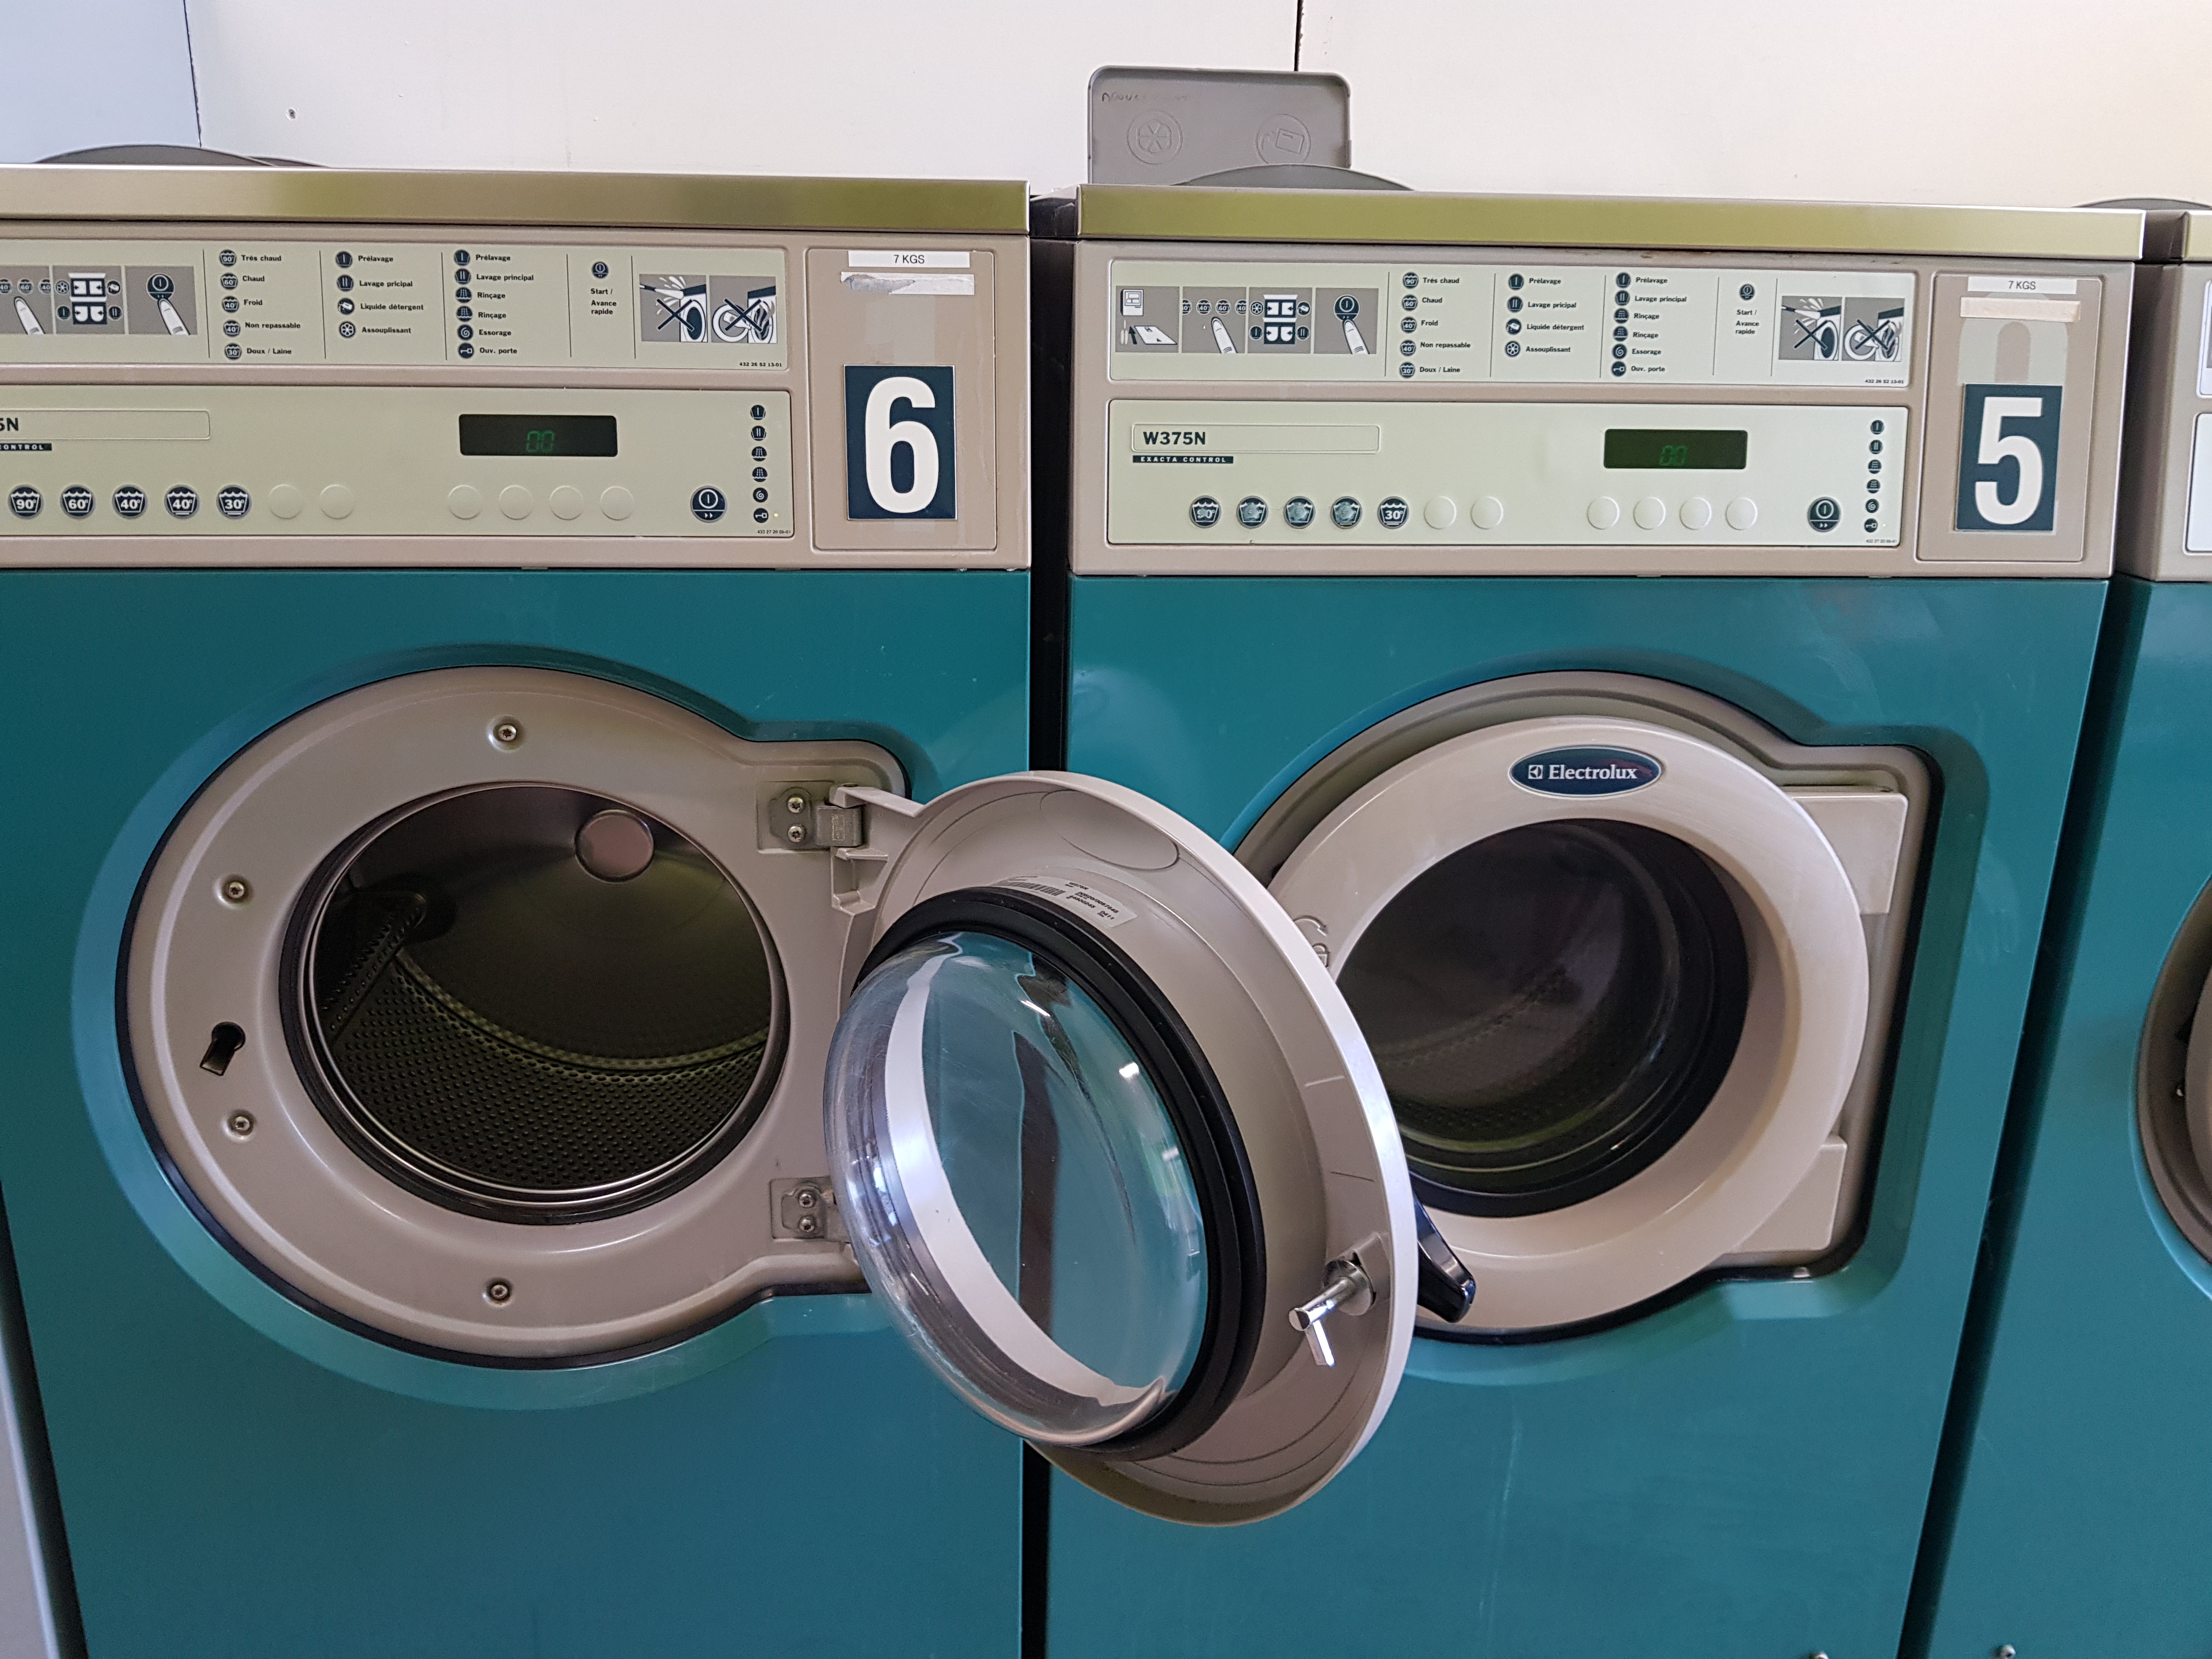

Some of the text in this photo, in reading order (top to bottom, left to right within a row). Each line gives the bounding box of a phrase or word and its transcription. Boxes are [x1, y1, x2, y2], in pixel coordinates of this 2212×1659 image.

[894, 254, 925, 264] 7 KGS
[2008, 281, 2036, 290] 7 KGS
[865, 376, 940, 514] 6
[1143, 432, 1205, 445] W375N
[1974, 397, 2043, 524] 5
[1549, 764, 1638, 780] Electrolux
